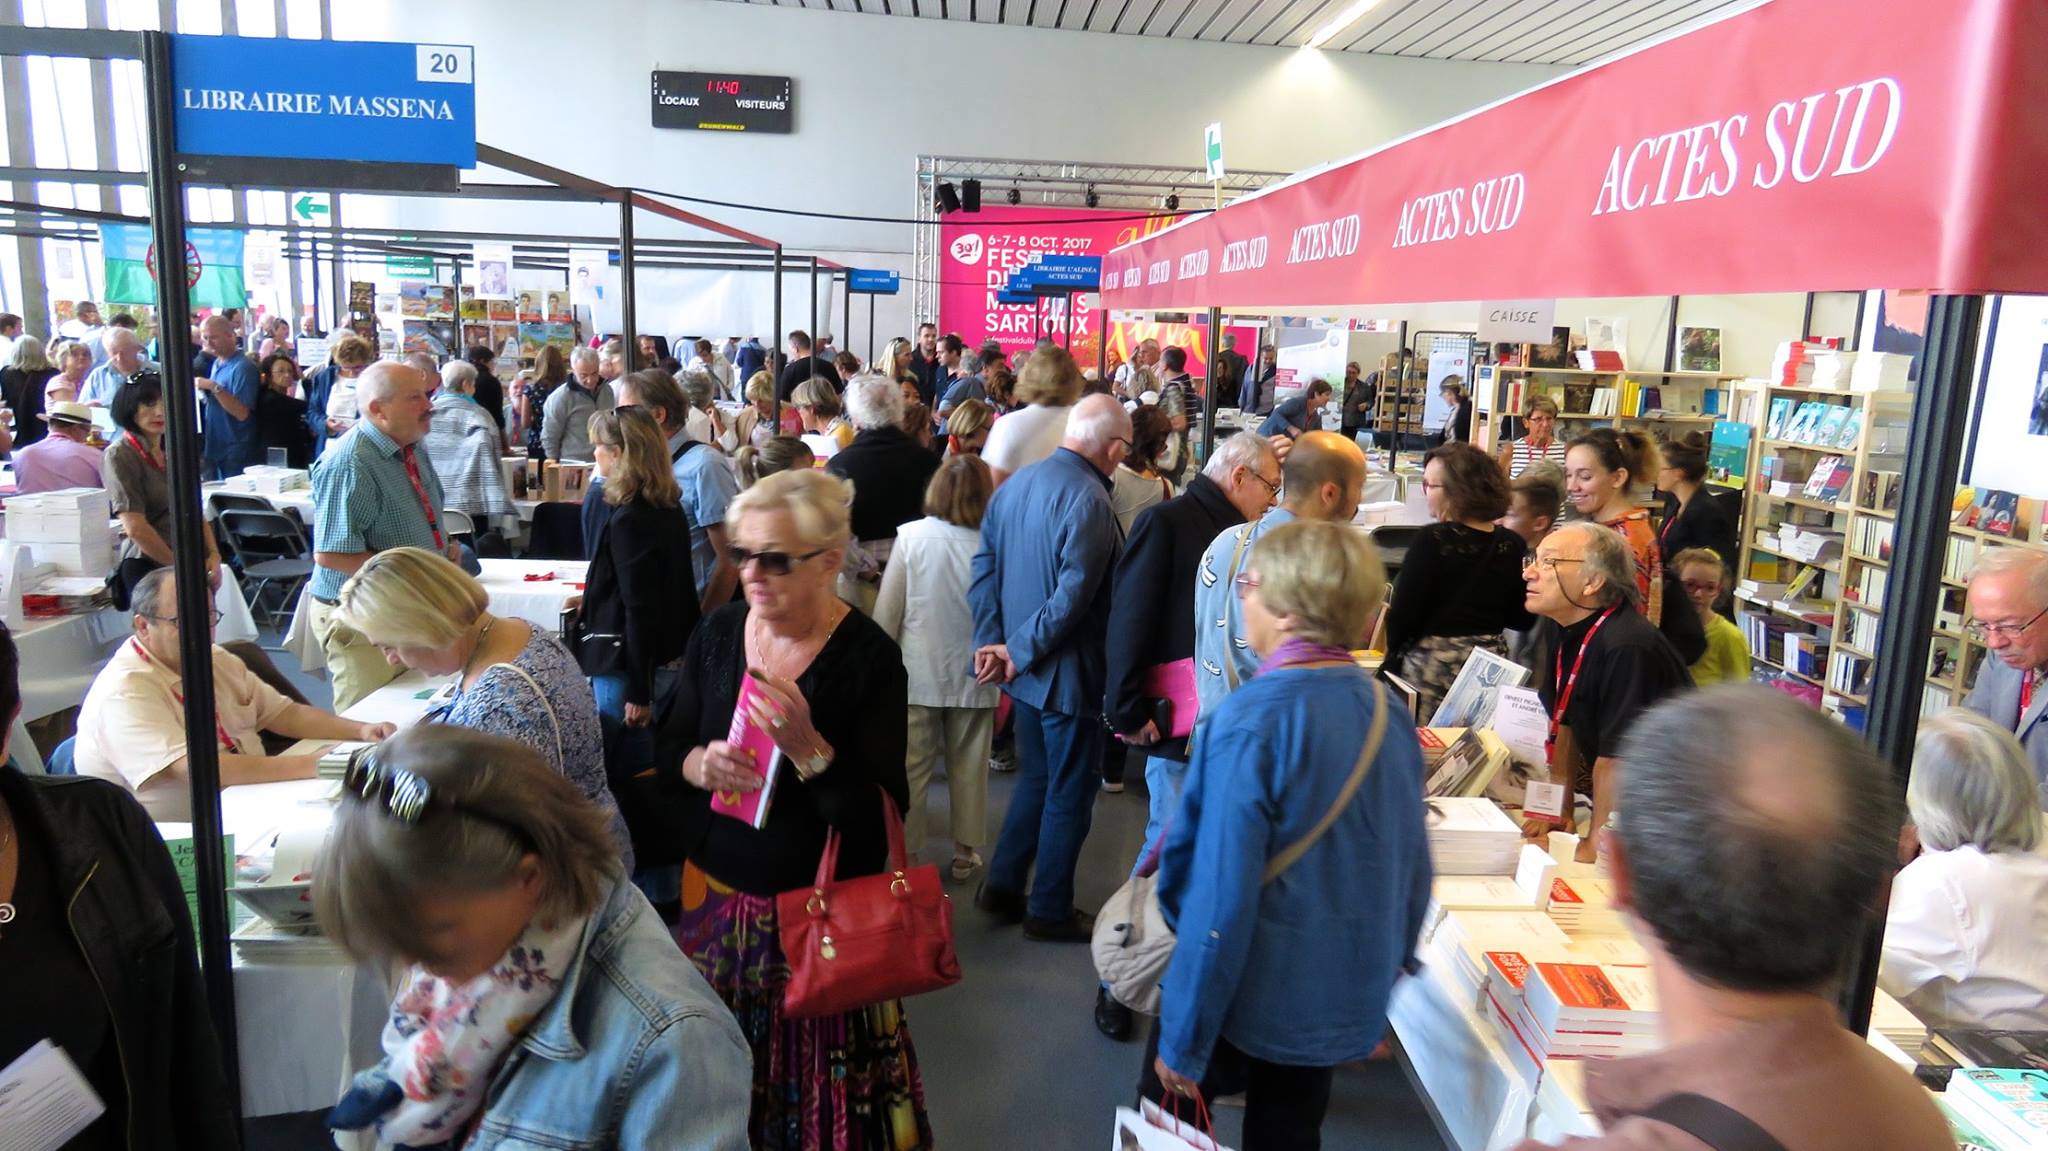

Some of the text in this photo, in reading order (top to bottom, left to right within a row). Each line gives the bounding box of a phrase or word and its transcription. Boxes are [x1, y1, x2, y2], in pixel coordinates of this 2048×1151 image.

[429, 52, 459, 75] 20
[658, 96, 700, 107] LOCAUX
[706, 80, 740, 96] 11:40
[182, 87, 456, 121] LIBRAIRIE MASSENA
[735, 99, 787, 111] VISITEURS
[1591, 76, 1903, 217] ACTES SUD
[1391, 171, 1527, 250] ACTES SUD
[1029, 236, 1059, 249] OCT.
[1062, 237, 1093, 250] 2017
[1285, 213, 1362, 265] ACTES SUD
[1218, 235, 1268, 273] ACTES SUD
